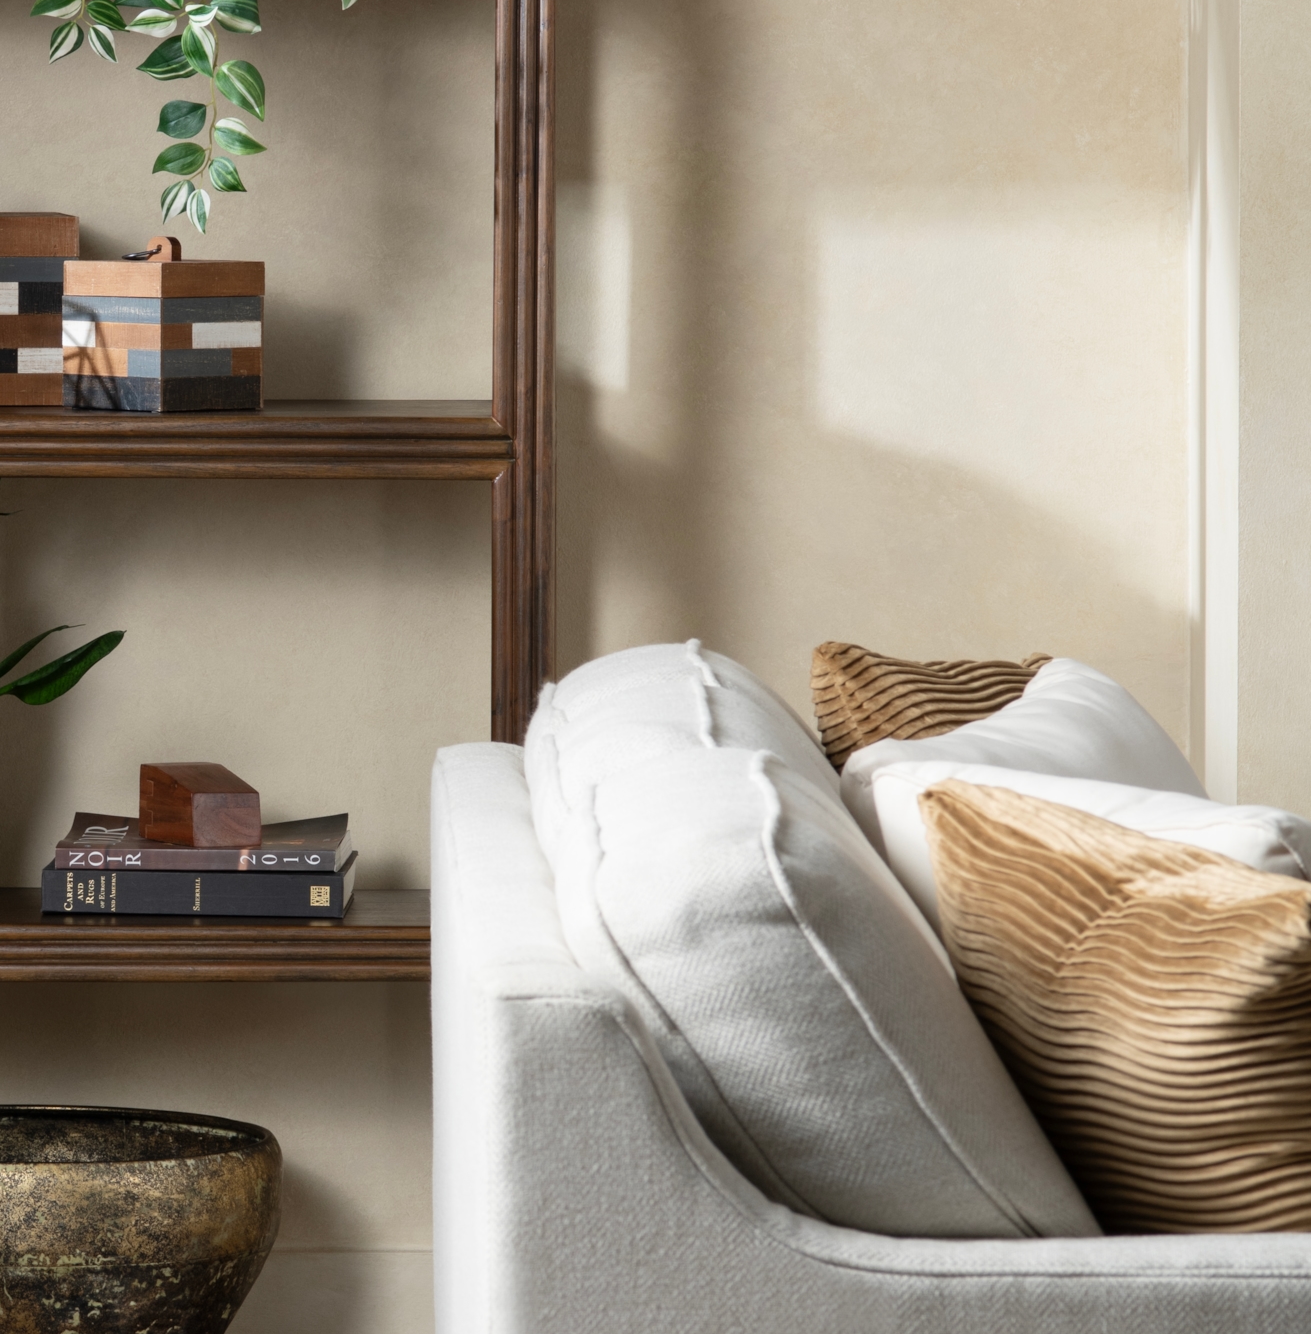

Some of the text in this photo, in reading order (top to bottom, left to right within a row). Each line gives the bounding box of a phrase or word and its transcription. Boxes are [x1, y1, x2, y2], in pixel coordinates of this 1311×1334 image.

[69, 851, 321, 867] NOIR 2016
[63, 872, 74, 911] CARPETS
[85, 879, 95, 904] RUGS
[192, 877, 200, 911] SHERRILL
